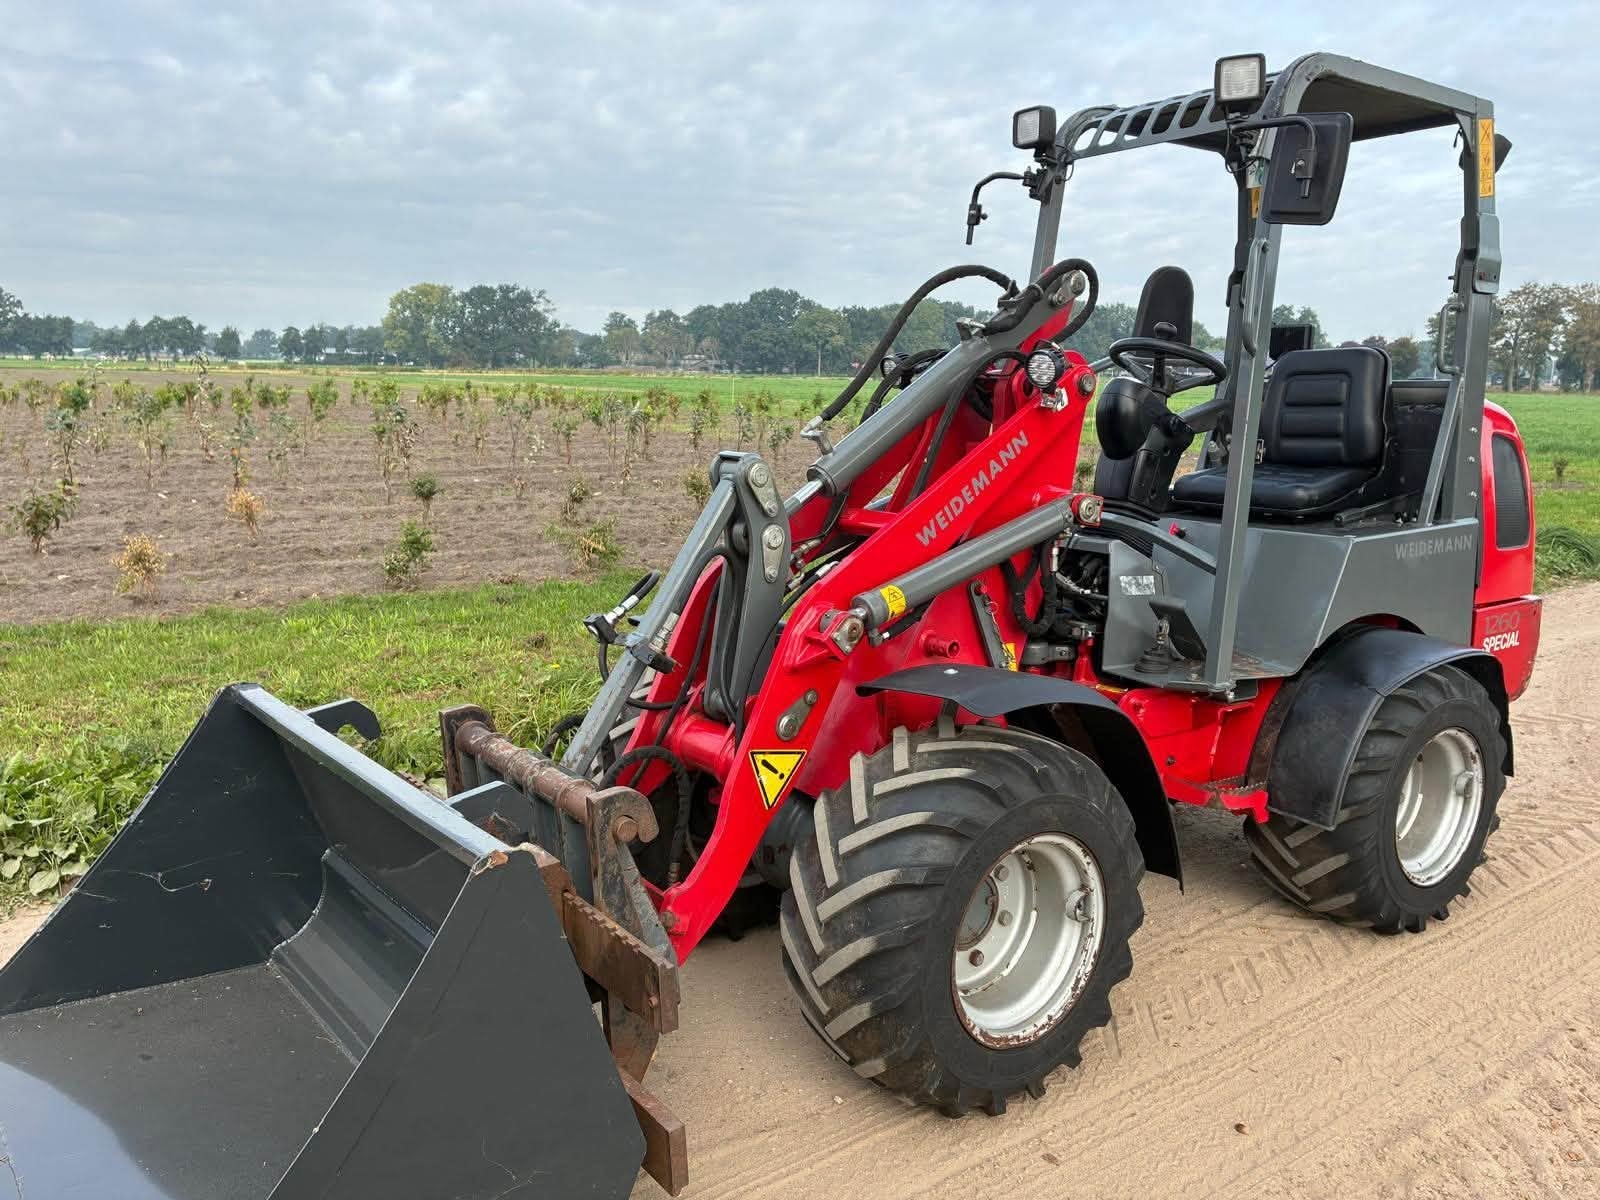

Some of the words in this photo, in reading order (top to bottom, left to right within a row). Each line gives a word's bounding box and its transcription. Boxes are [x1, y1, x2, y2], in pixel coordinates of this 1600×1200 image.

[915, 430, 1028, 546] WEIDEMANN
[1395, 534, 1473, 560] WEIDEMANN
[1484, 611, 1520, 635] 1260
[1482, 631, 1520, 652] SPECIAL
